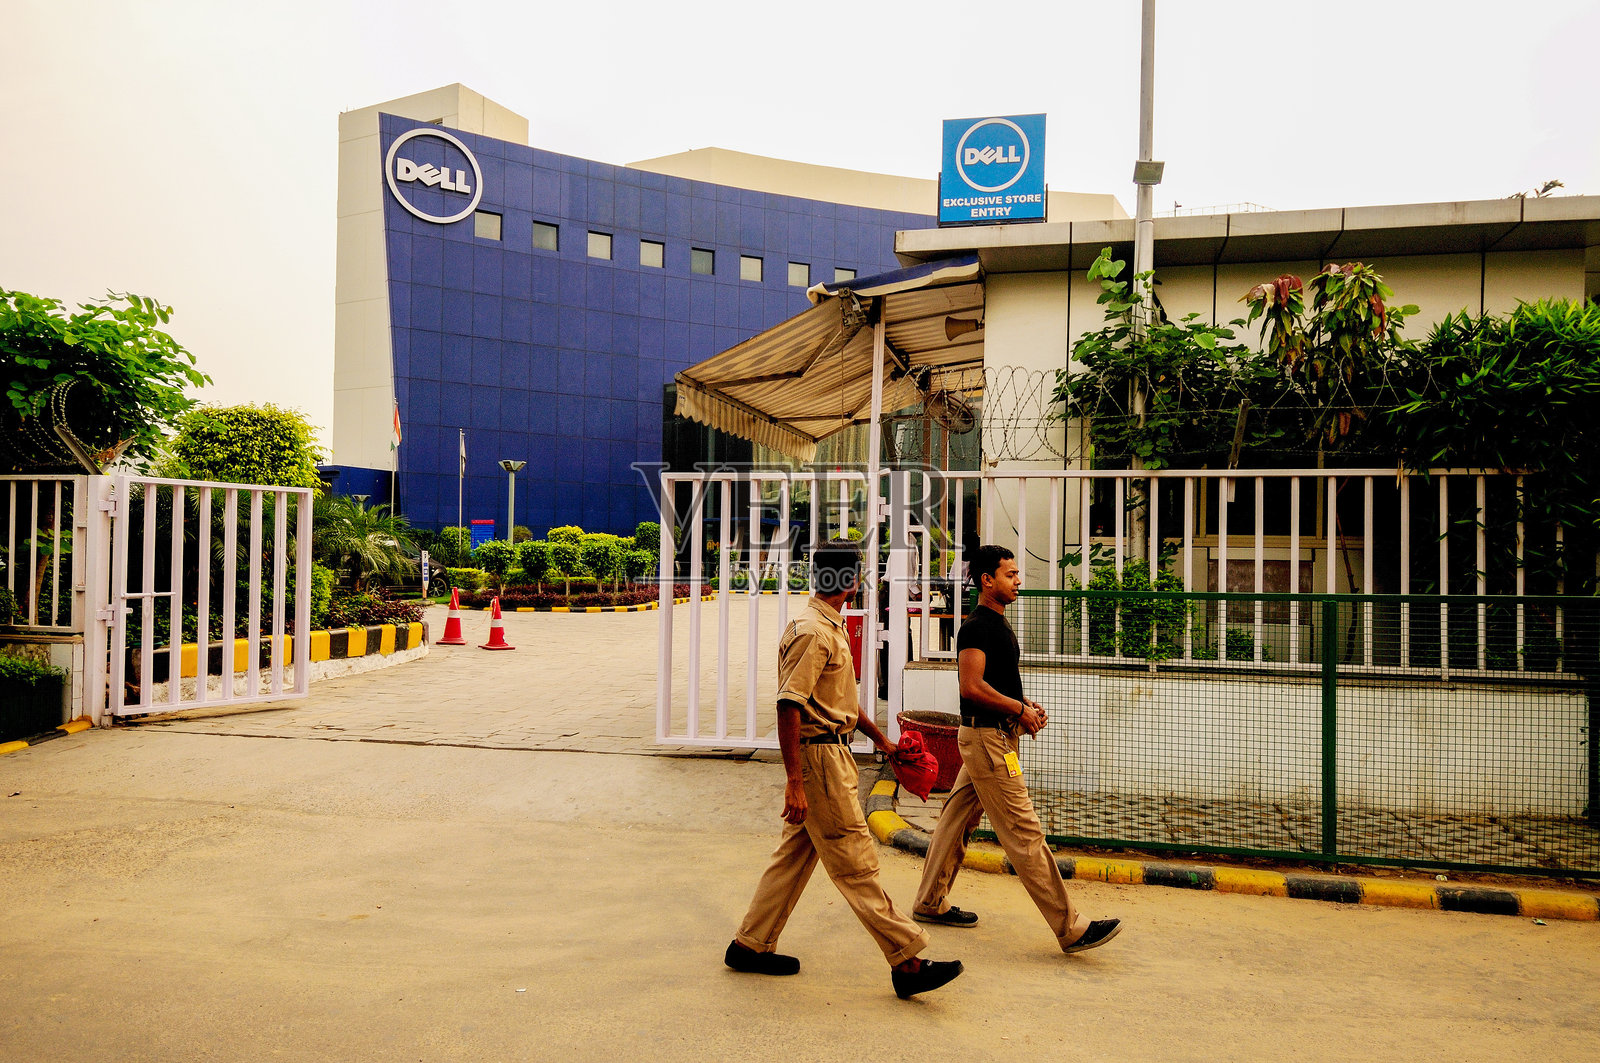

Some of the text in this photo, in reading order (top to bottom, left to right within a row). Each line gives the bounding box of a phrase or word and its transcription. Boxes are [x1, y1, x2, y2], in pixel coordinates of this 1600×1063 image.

[964, 145, 1020, 165] DELL
[396, 157, 470, 194] DELL
[943, 194, 1041, 207] EXCLUSIVE STORE
[970, 207, 1012, 218] ENTRY
